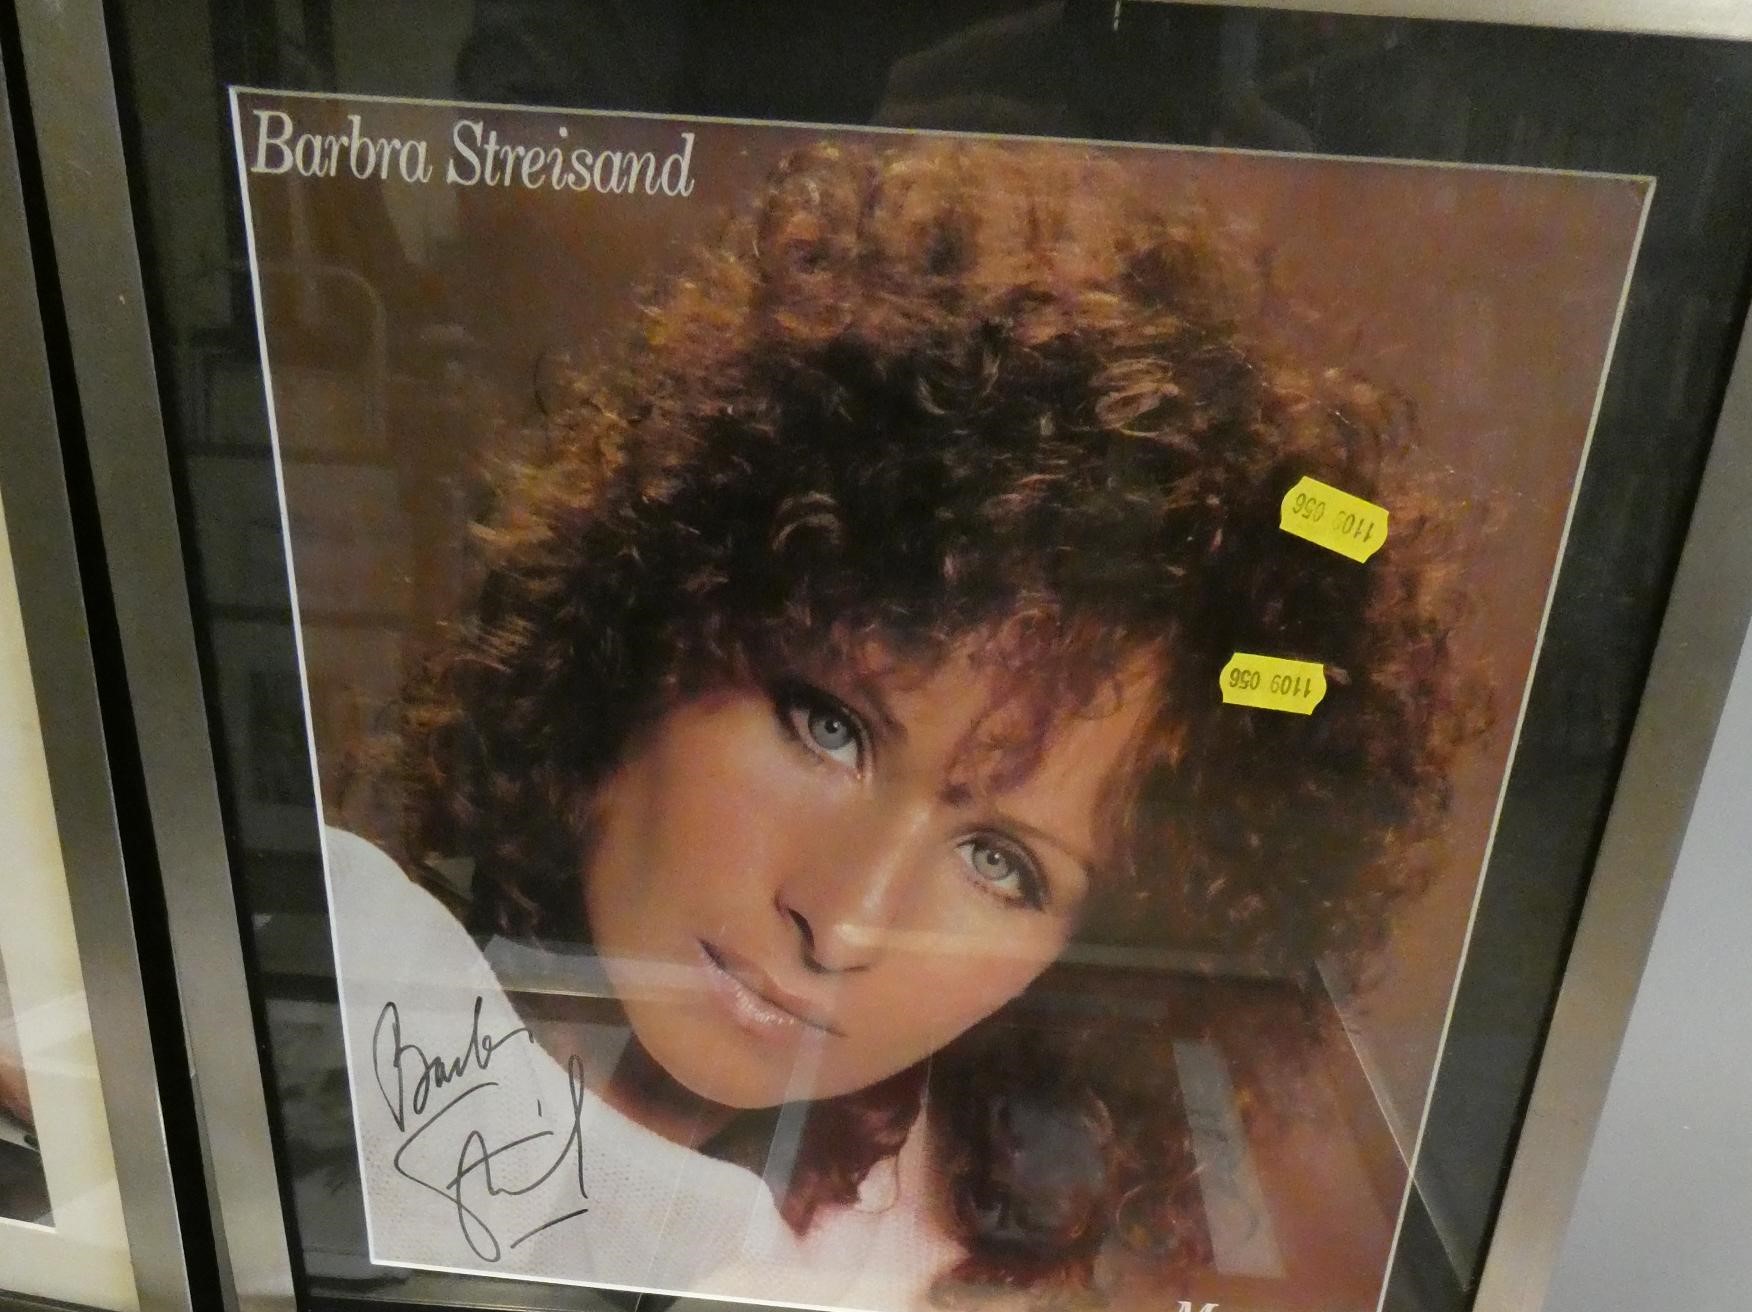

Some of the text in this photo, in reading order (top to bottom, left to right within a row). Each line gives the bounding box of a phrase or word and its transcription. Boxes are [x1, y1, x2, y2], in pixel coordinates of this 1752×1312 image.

[250, 109, 695, 198] Barbra Streisand
[1291, 492, 1376, 544] 1109 056
[1229, 667, 1312, 699] 1109 056
